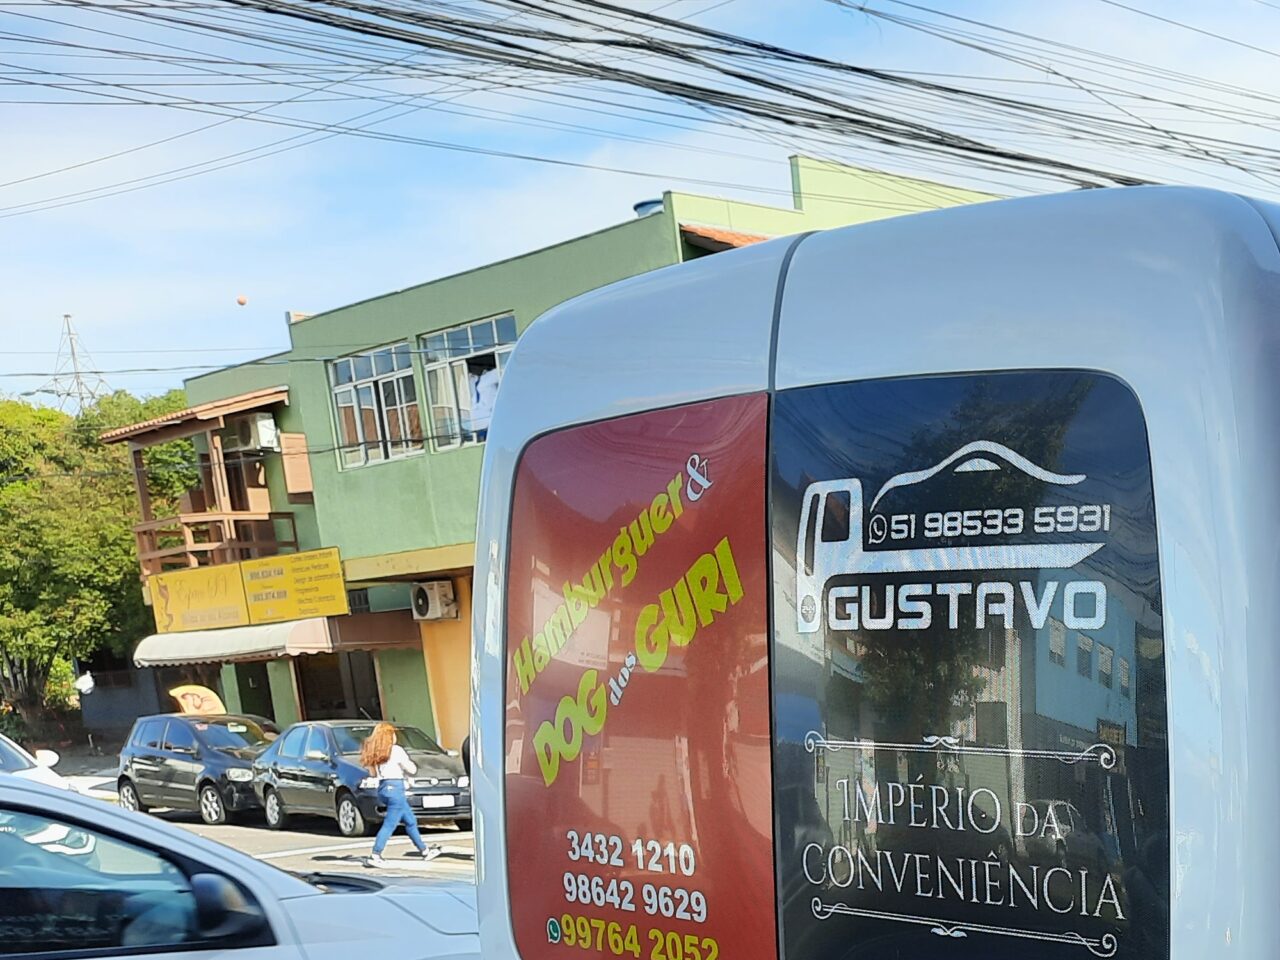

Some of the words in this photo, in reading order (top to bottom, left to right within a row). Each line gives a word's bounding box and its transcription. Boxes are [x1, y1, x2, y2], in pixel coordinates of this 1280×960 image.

[891, 514, 916, 540] 51
[924, 508, 1024, 538] 98533
[1034, 504, 1111, 533] 5931
[513, 471, 684, 695] Hamburguer
[686, 454, 714, 501] &
[828, 580, 1107, 631] GUSTAVO
[533, 668, 607, 787] DOG
[608, 651, 637, 706] dos
[635, 536, 744, 673] GURI
[836, 774, 1002, 834] IMPÉRIO
[566, 830, 624, 867] 3432
[632, 839, 695, 876] 1210
[563, 872, 636, 911] 98642
[642, 883, 708, 923] 9629
[802, 842, 1127, 920] CONVENIÊNCIA
[561, 913, 641, 958] 99764
